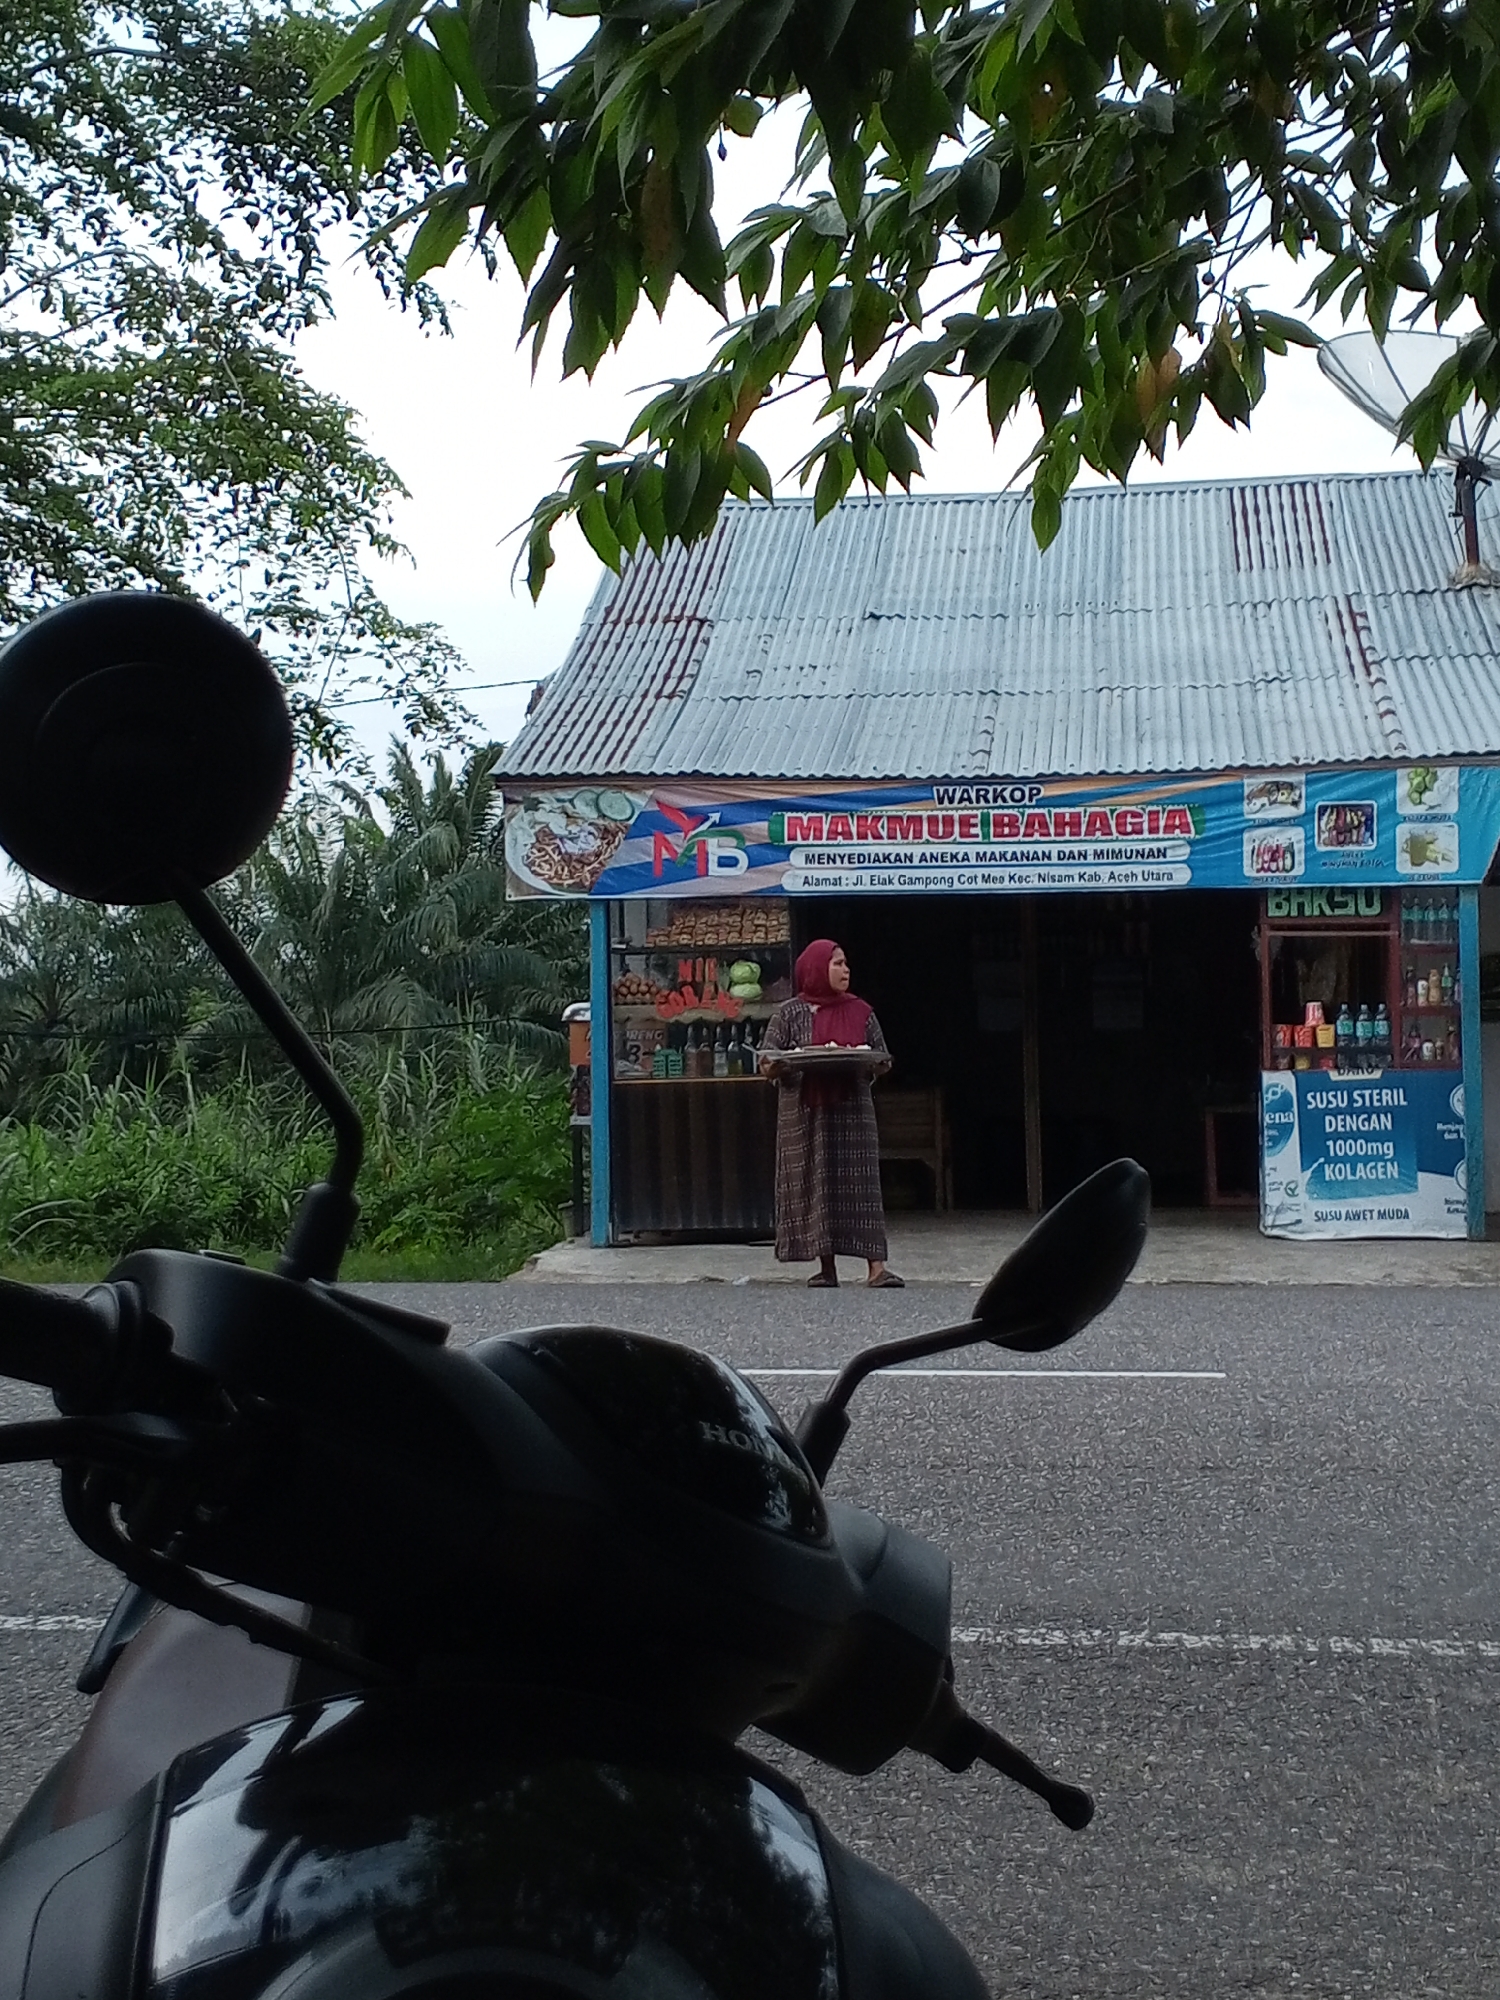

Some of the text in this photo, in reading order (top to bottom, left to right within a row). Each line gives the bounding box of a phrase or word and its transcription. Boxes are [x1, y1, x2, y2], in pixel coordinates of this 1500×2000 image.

[935, 785, 1042, 807] WARKOP
[786, 807, 1193, 842] MAKMUE BAHAGIA
[804, 852, 914, 865] MENYEDIAKAN
[918, 851, 971, 864] ANEKA
[975, 850, 1052, 863] MAKANAN
[1057, 849, 1088, 861] DAN
[802, 875, 843, 887] Alamat
[898, 873, 954, 889] Gampong
[957, 873, 979, 886] Cot
[1108, 870, 1138, 883] Aceh
[1141, 869, 1174, 882] Utara
[1306, 1087, 1408, 1110] SUSU STERIL
[1324, 1112, 1393, 1133] DENGAN
[1326, 1139, 1395, 1159] 1000mg
[1324, 1161, 1399, 1181] KOLAGEN
[1314, 1208, 1410, 1222] SUSU AWET MUDA
